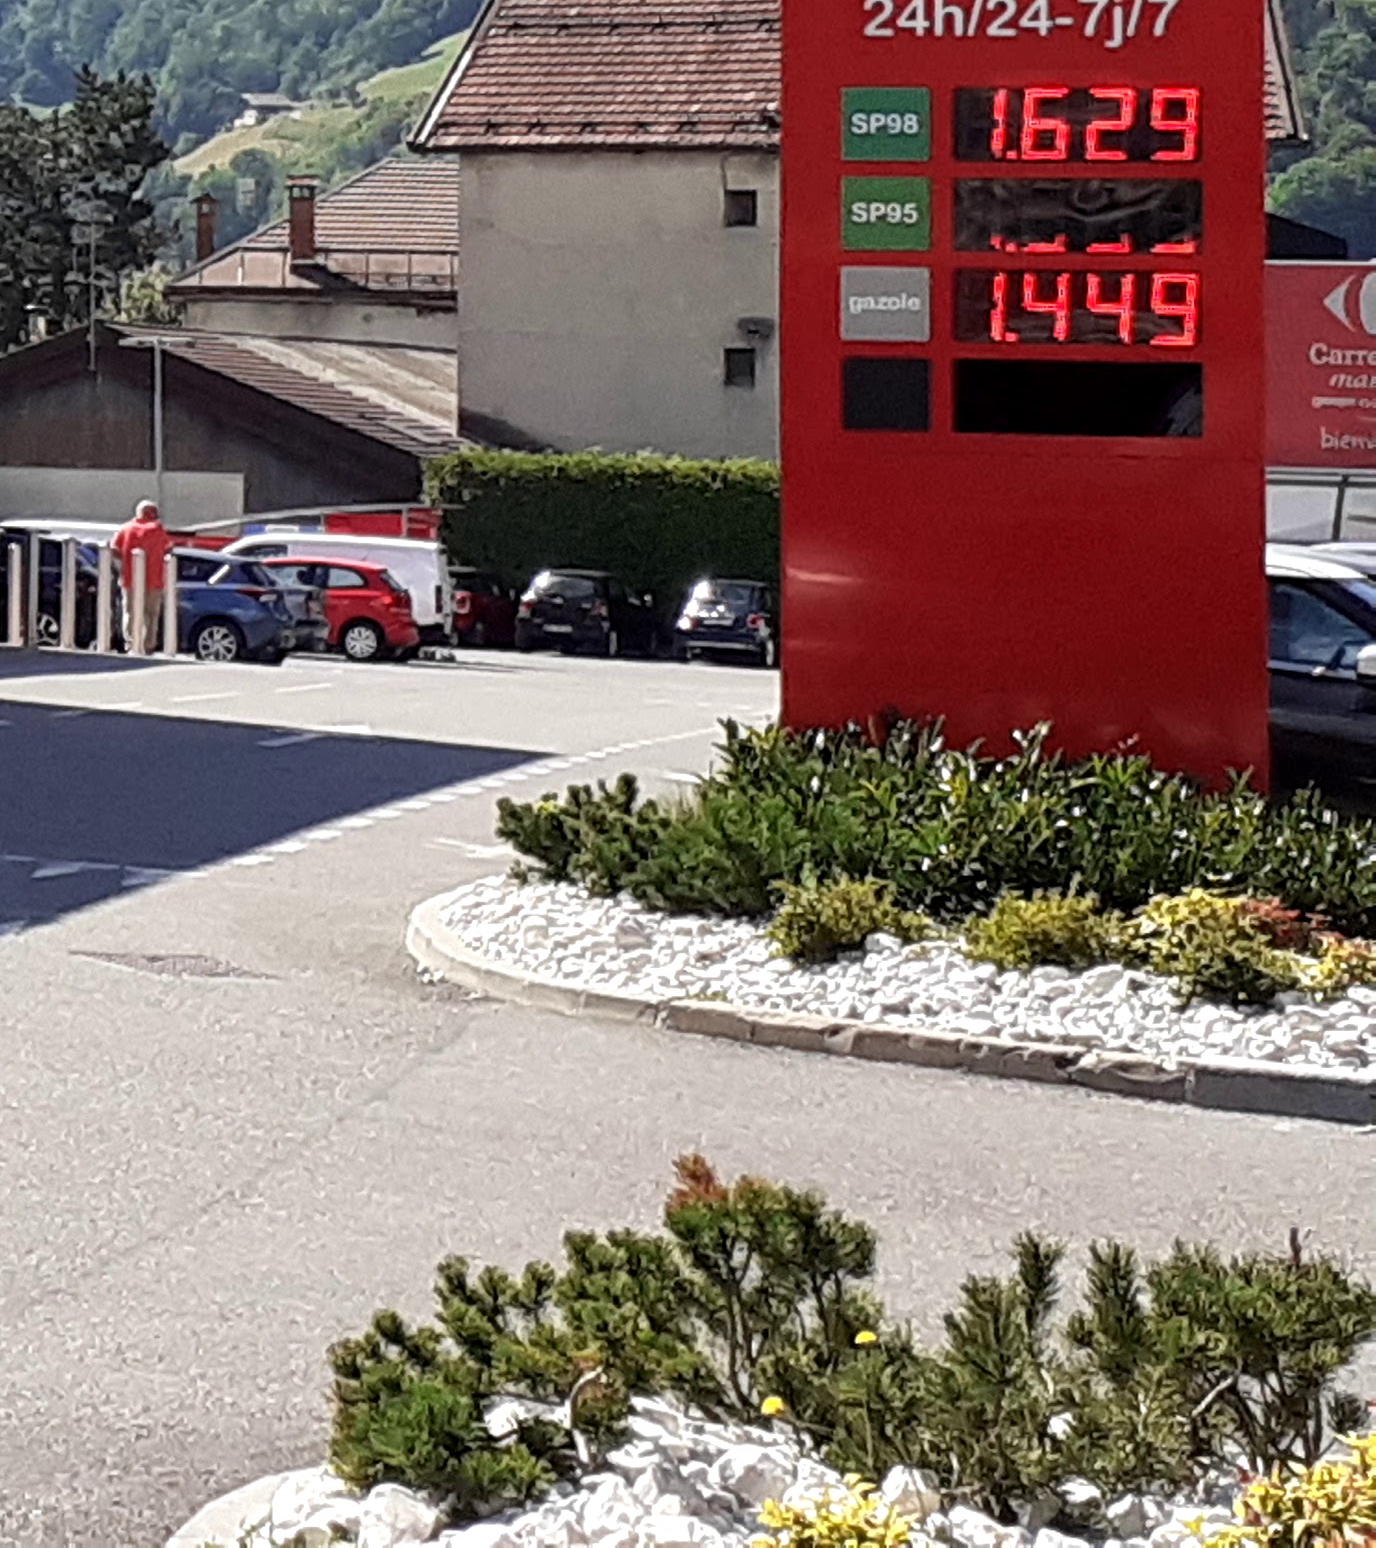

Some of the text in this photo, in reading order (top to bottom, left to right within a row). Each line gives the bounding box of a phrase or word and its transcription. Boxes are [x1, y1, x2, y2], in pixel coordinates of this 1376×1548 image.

[850, 112, 920, 135] SP98
[851, 201, 919, 224] SP95
[848, 292, 922, 315] gazole
